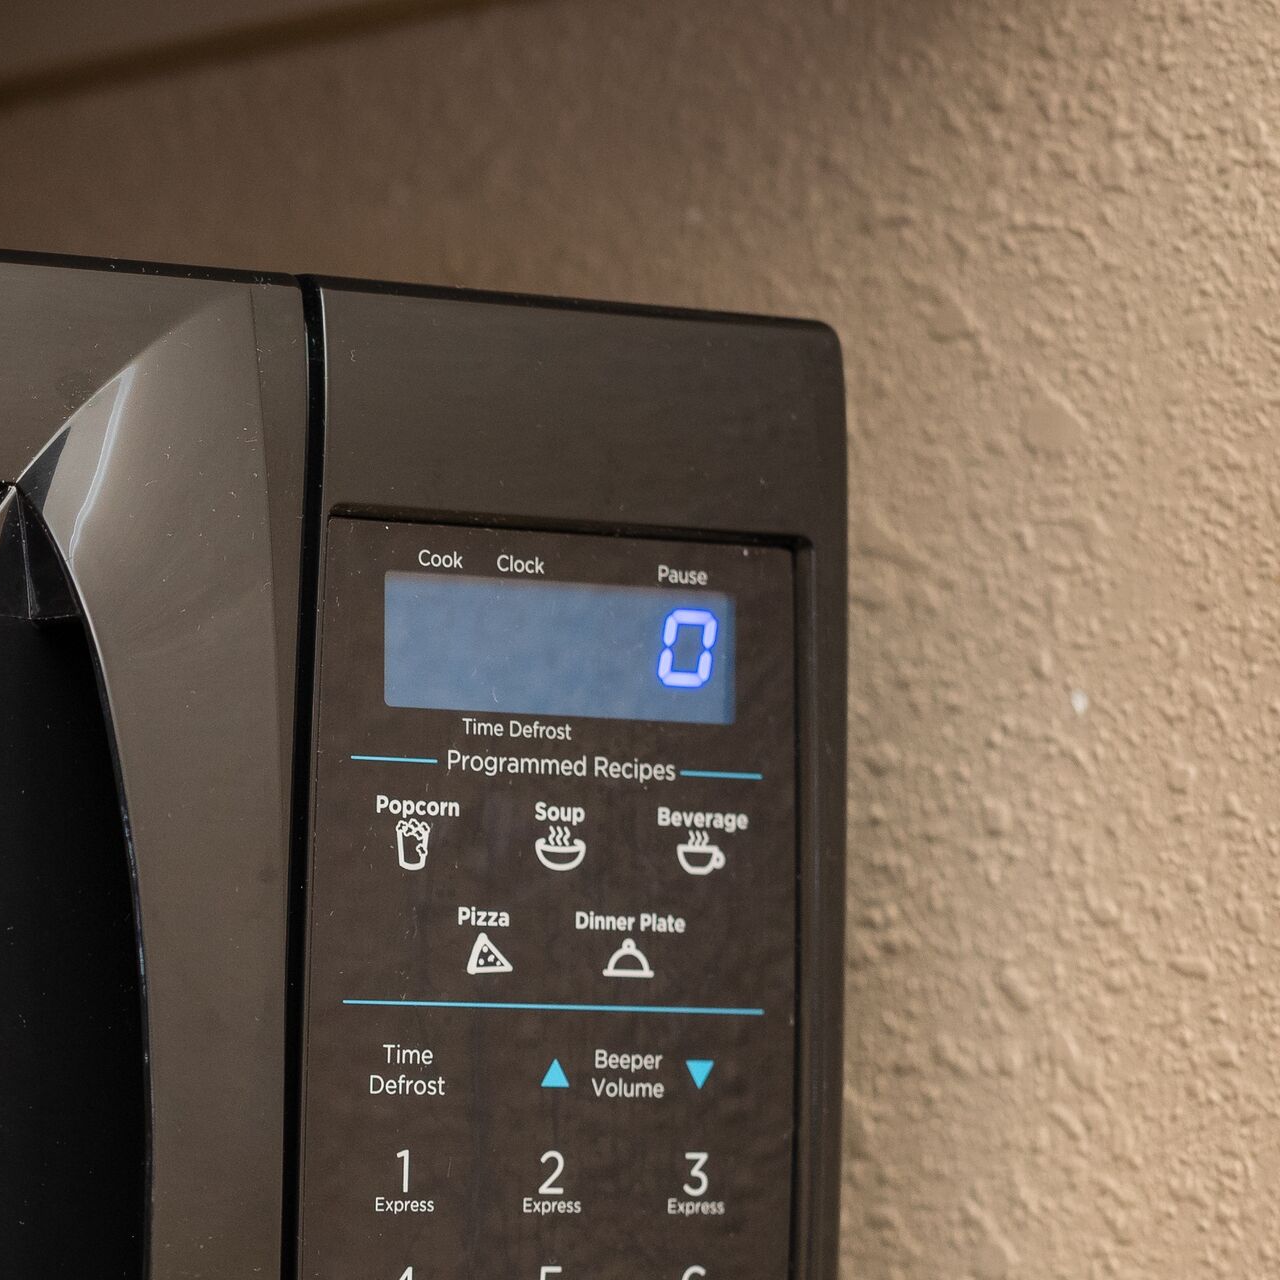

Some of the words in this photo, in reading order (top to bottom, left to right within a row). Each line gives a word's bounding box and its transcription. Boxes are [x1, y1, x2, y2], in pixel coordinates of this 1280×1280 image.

[418, 549, 463, 569] Cook
[497, 555, 544, 575] Clock
[657, 565, 708, 586] Pause
[657, 607, 718, 689] 0
[462, 718, 504, 737] Time
[510, 720, 571, 741] Defrost
[447, 750, 587, 777] Programmed
[594, 757, 676, 783] Recipes
[376, 795, 460, 819] Popcorn
[535, 803, 585, 824] Soup
[657, 807, 749, 833] Beverage
[458, 907, 510, 927] Pizza
[575, 912, 635, 931] Dinner
[640, 913, 686, 933] Plate
[382, 1046, 433, 1064] Time
[594, 1050, 663, 1071] Beeper
[369, 1075, 445, 1096] Defrost
[592, 1078, 664, 1099] Volume
[396, 1149, 410, 1192] 1
[539, 1151, 565, 1194] 2
[684, 1152, 709, 1196] 3
[375, 1198, 434, 1215] Express
[522, 1198, 582, 1216] Express
[667, 1199, 725, 1217] Express
